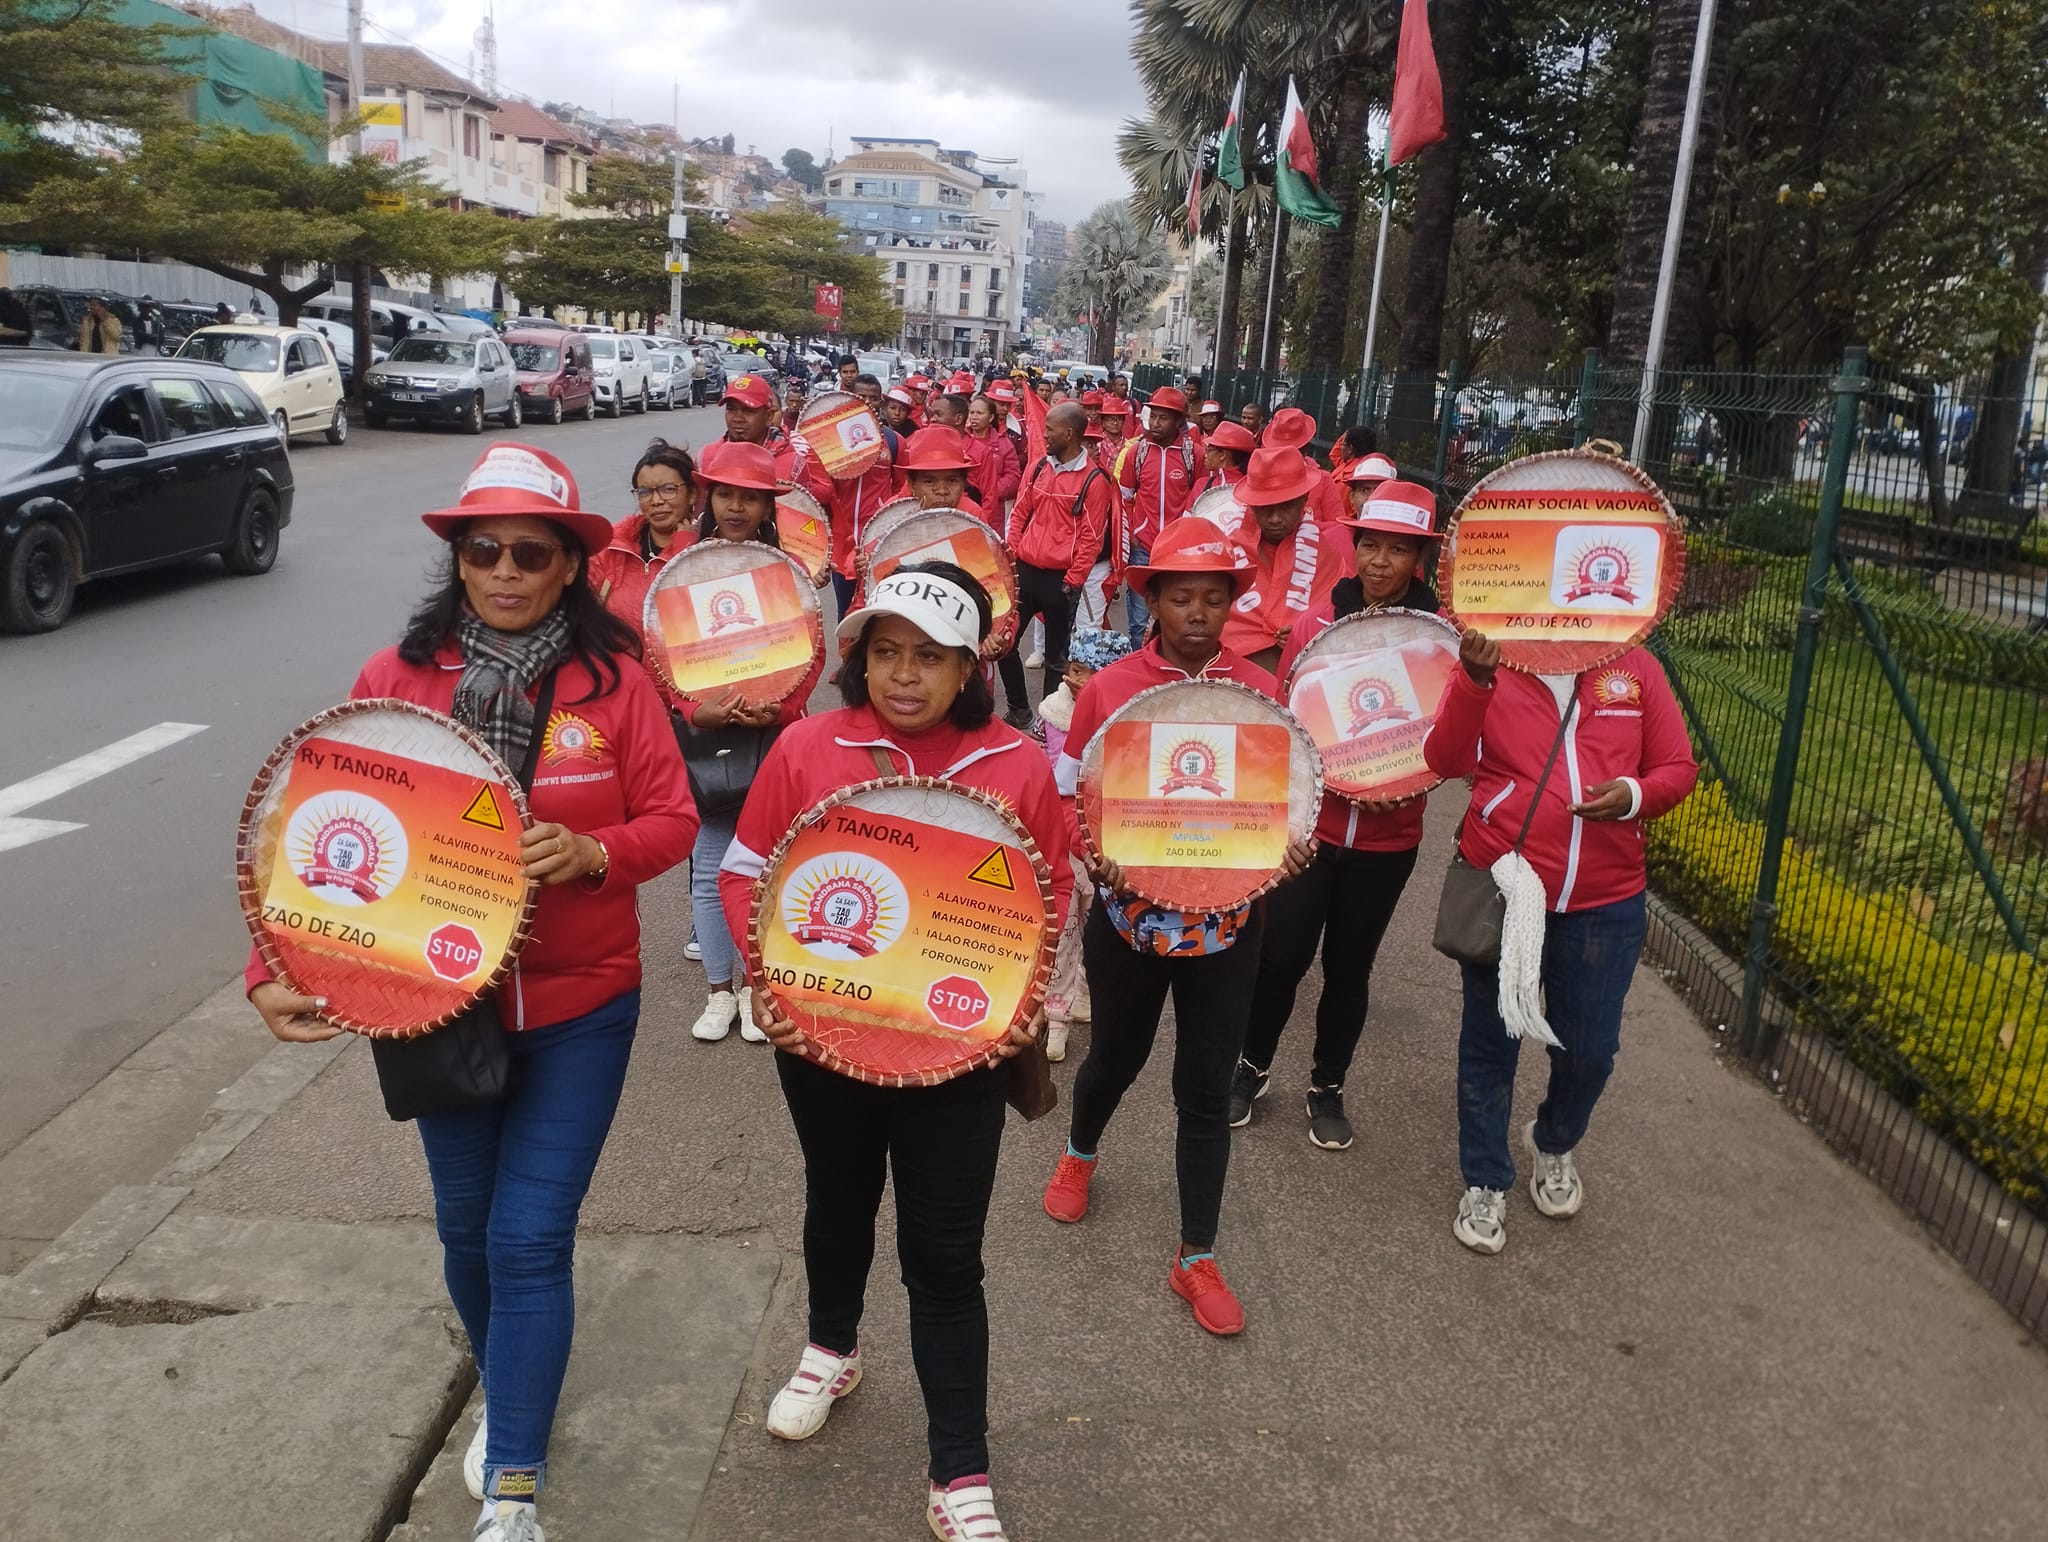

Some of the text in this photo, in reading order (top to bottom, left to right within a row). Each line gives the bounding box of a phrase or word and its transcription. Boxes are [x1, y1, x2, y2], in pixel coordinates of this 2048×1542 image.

[1468, 497, 1661, 513] CONTRAT SOCIAL VAOVAO
[1470, 530, 1510, 541] KARAMA
[1466, 563, 1521, 572] CPS/CNAPS
[1465, 579, 1546, 588] FAHASALAMANA
[870, 580, 972, 622] PORT
[1462, 595, 1488, 604] /SMT
[1505, 615, 1593, 629] ZAO DE ZAO
[300, 747, 416, 792] Ry TANORA,
[1359, 767, 1373, 777] eo
[1375, 752, 1424, 773] anivon'n
[317, 821, 351, 854] RANDRANA
[835, 816, 921, 853] TANORA,
[1120, 819, 1167, 829] ATSAHARO
[1169, 820, 1182, 829] NY
[1234, 822, 1258, 831] ATAO
[433, 831, 479, 855] ALAVIRO
[480, 846, 495, 858] NY
[1166, 847, 1222, 857] ZAO DE ZAO!
[429, 853, 515, 886] MAHADOMELINA
[424, 873, 457, 893] IALAO
[492, 890, 506, 905] SY
[505, 896, 520, 909] NY
[813, 881, 874, 924] RANDRANA SENDIKALY
[420, 894, 489, 921] FORONGONY
[937, 890, 1039, 926] ALAVIRO NY ZAVA-
[262, 905, 377, 949] ZAO DE ZAO
[931, 910, 1023, 942] MAHADOMELINA
[431, 937, 479, 966] STOP
[926, 928, 962, 947] IALAO
[997, 946, 1013, 958] SY
[1013, 950, 1030, 963] NY
[921, 947, 994, 974] FORONGONY
[803, 972, 827, 992] DE
[835, 979, 873, 1001] ZAO
[931, 988, 986, 1014] STOP
